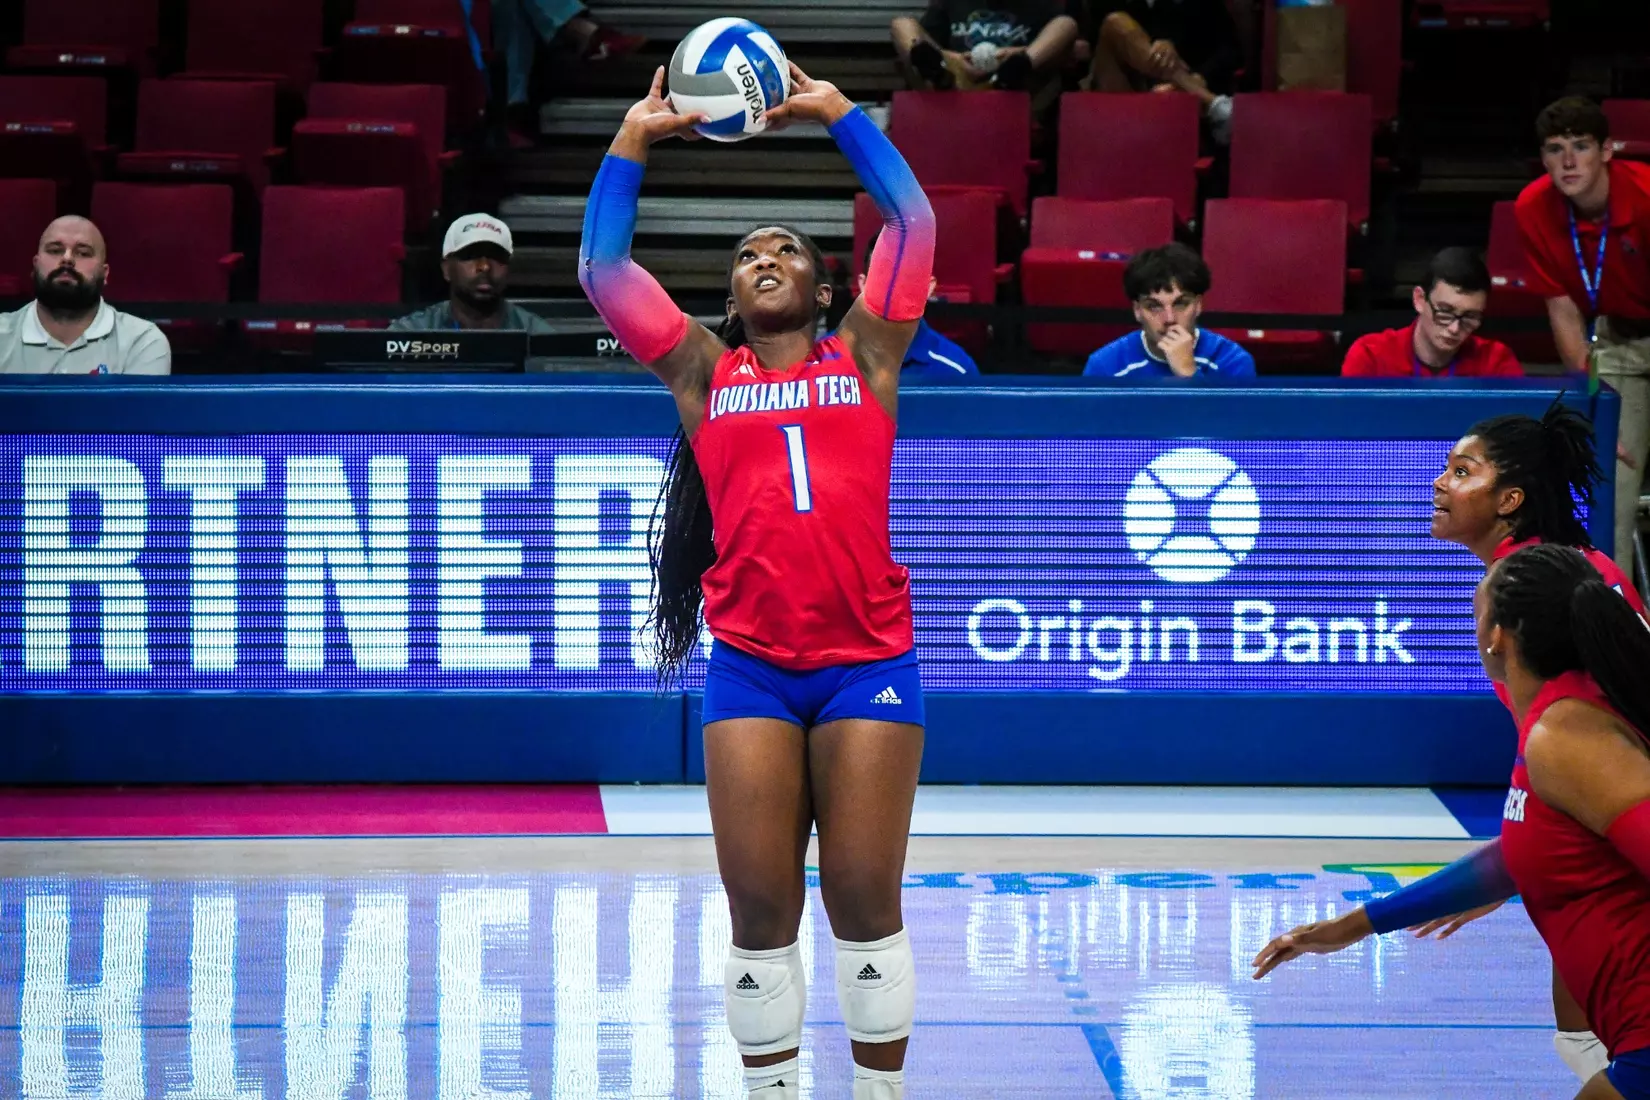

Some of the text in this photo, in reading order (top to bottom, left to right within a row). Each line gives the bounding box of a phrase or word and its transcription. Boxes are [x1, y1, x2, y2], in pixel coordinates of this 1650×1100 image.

[737, 63, 766, 124] molten
[596, 339, 624, 351] DV
[709, 374, 862, 421] LOUISIANA TECH
[778, 424, 813, 514] 1
[24, 454, 712, 672] RTNER
[968, 594, 1416, 681] Origin Bank
